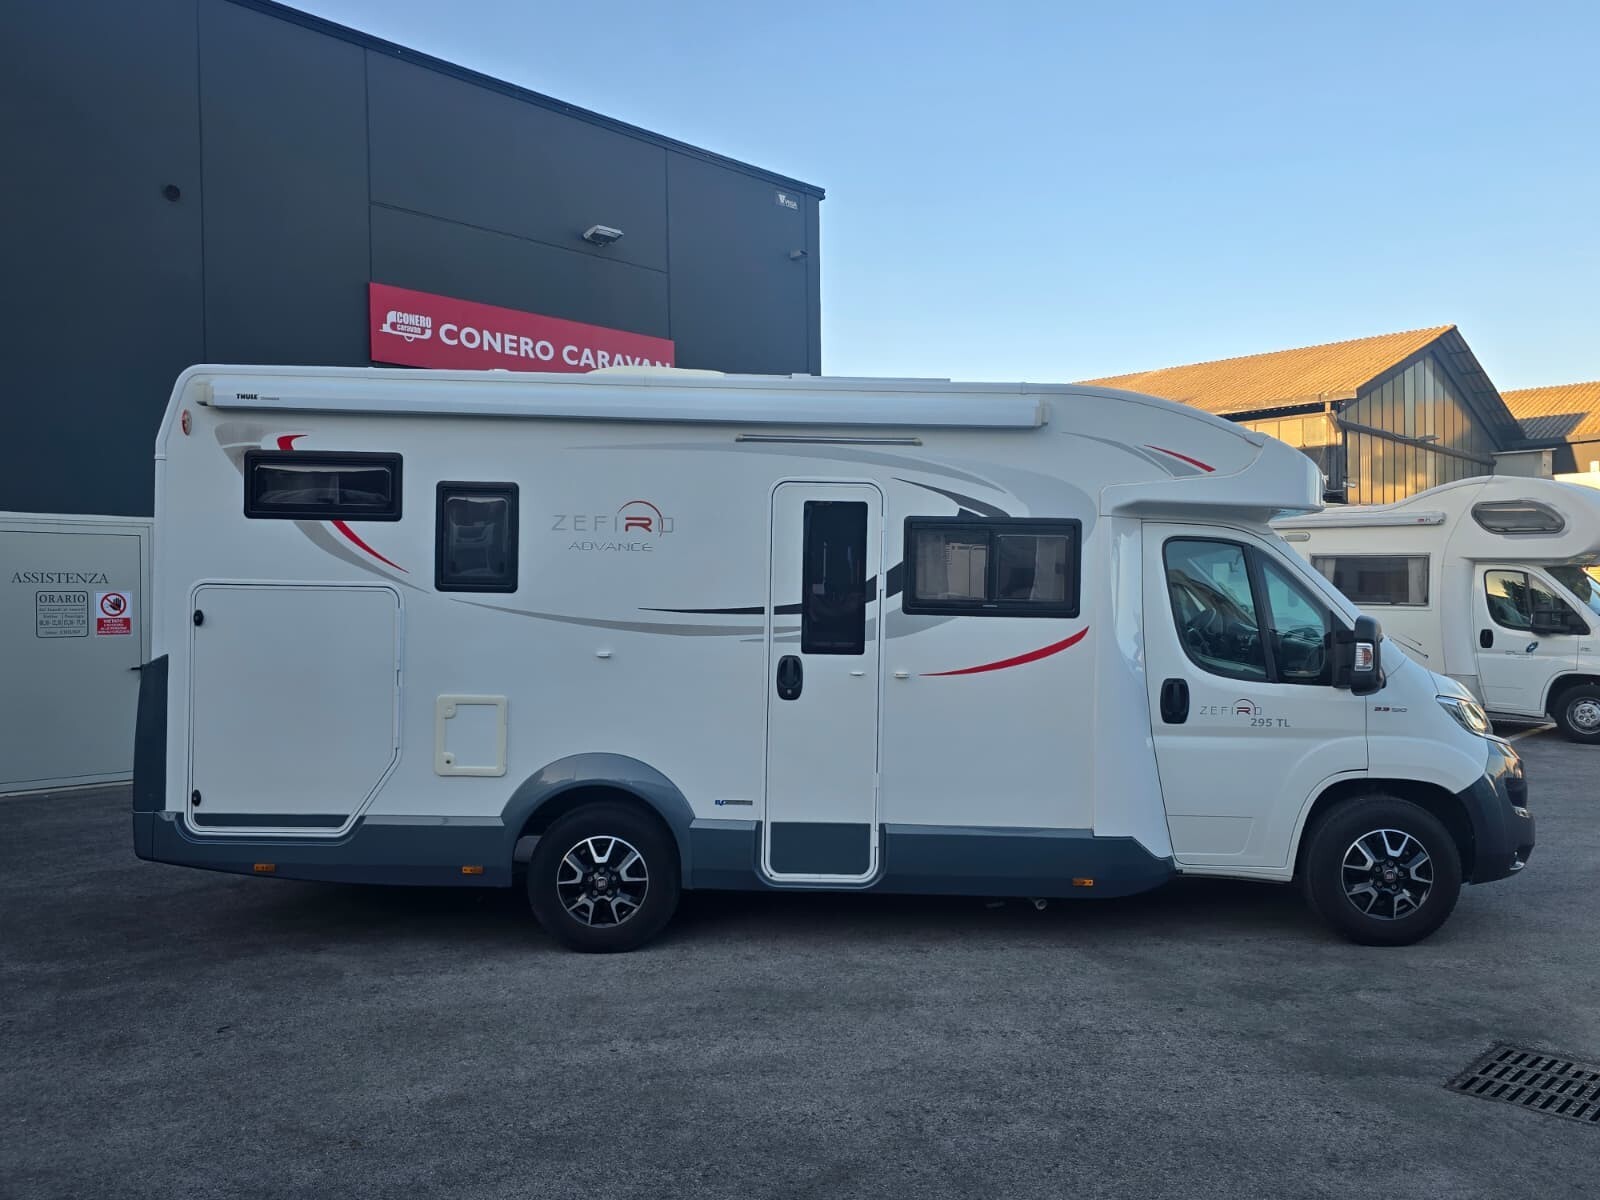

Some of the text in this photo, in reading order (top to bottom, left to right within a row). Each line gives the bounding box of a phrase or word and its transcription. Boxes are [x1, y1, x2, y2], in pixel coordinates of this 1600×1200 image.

[396, 311, 432, 329] CONERO
[439, 323, 555, 362] CONERO
[551, 514, 674, 533] ZEFIRO
[568, 541, 653, 552] ADVANCE
[11, 571, 109, 585] ASSISTENZA
[39, 594, 86, 604] ORARIO
[1199, 705, 1263, 716] ZEFIRO
[1250, 717, 1291, 728] 295 TL
